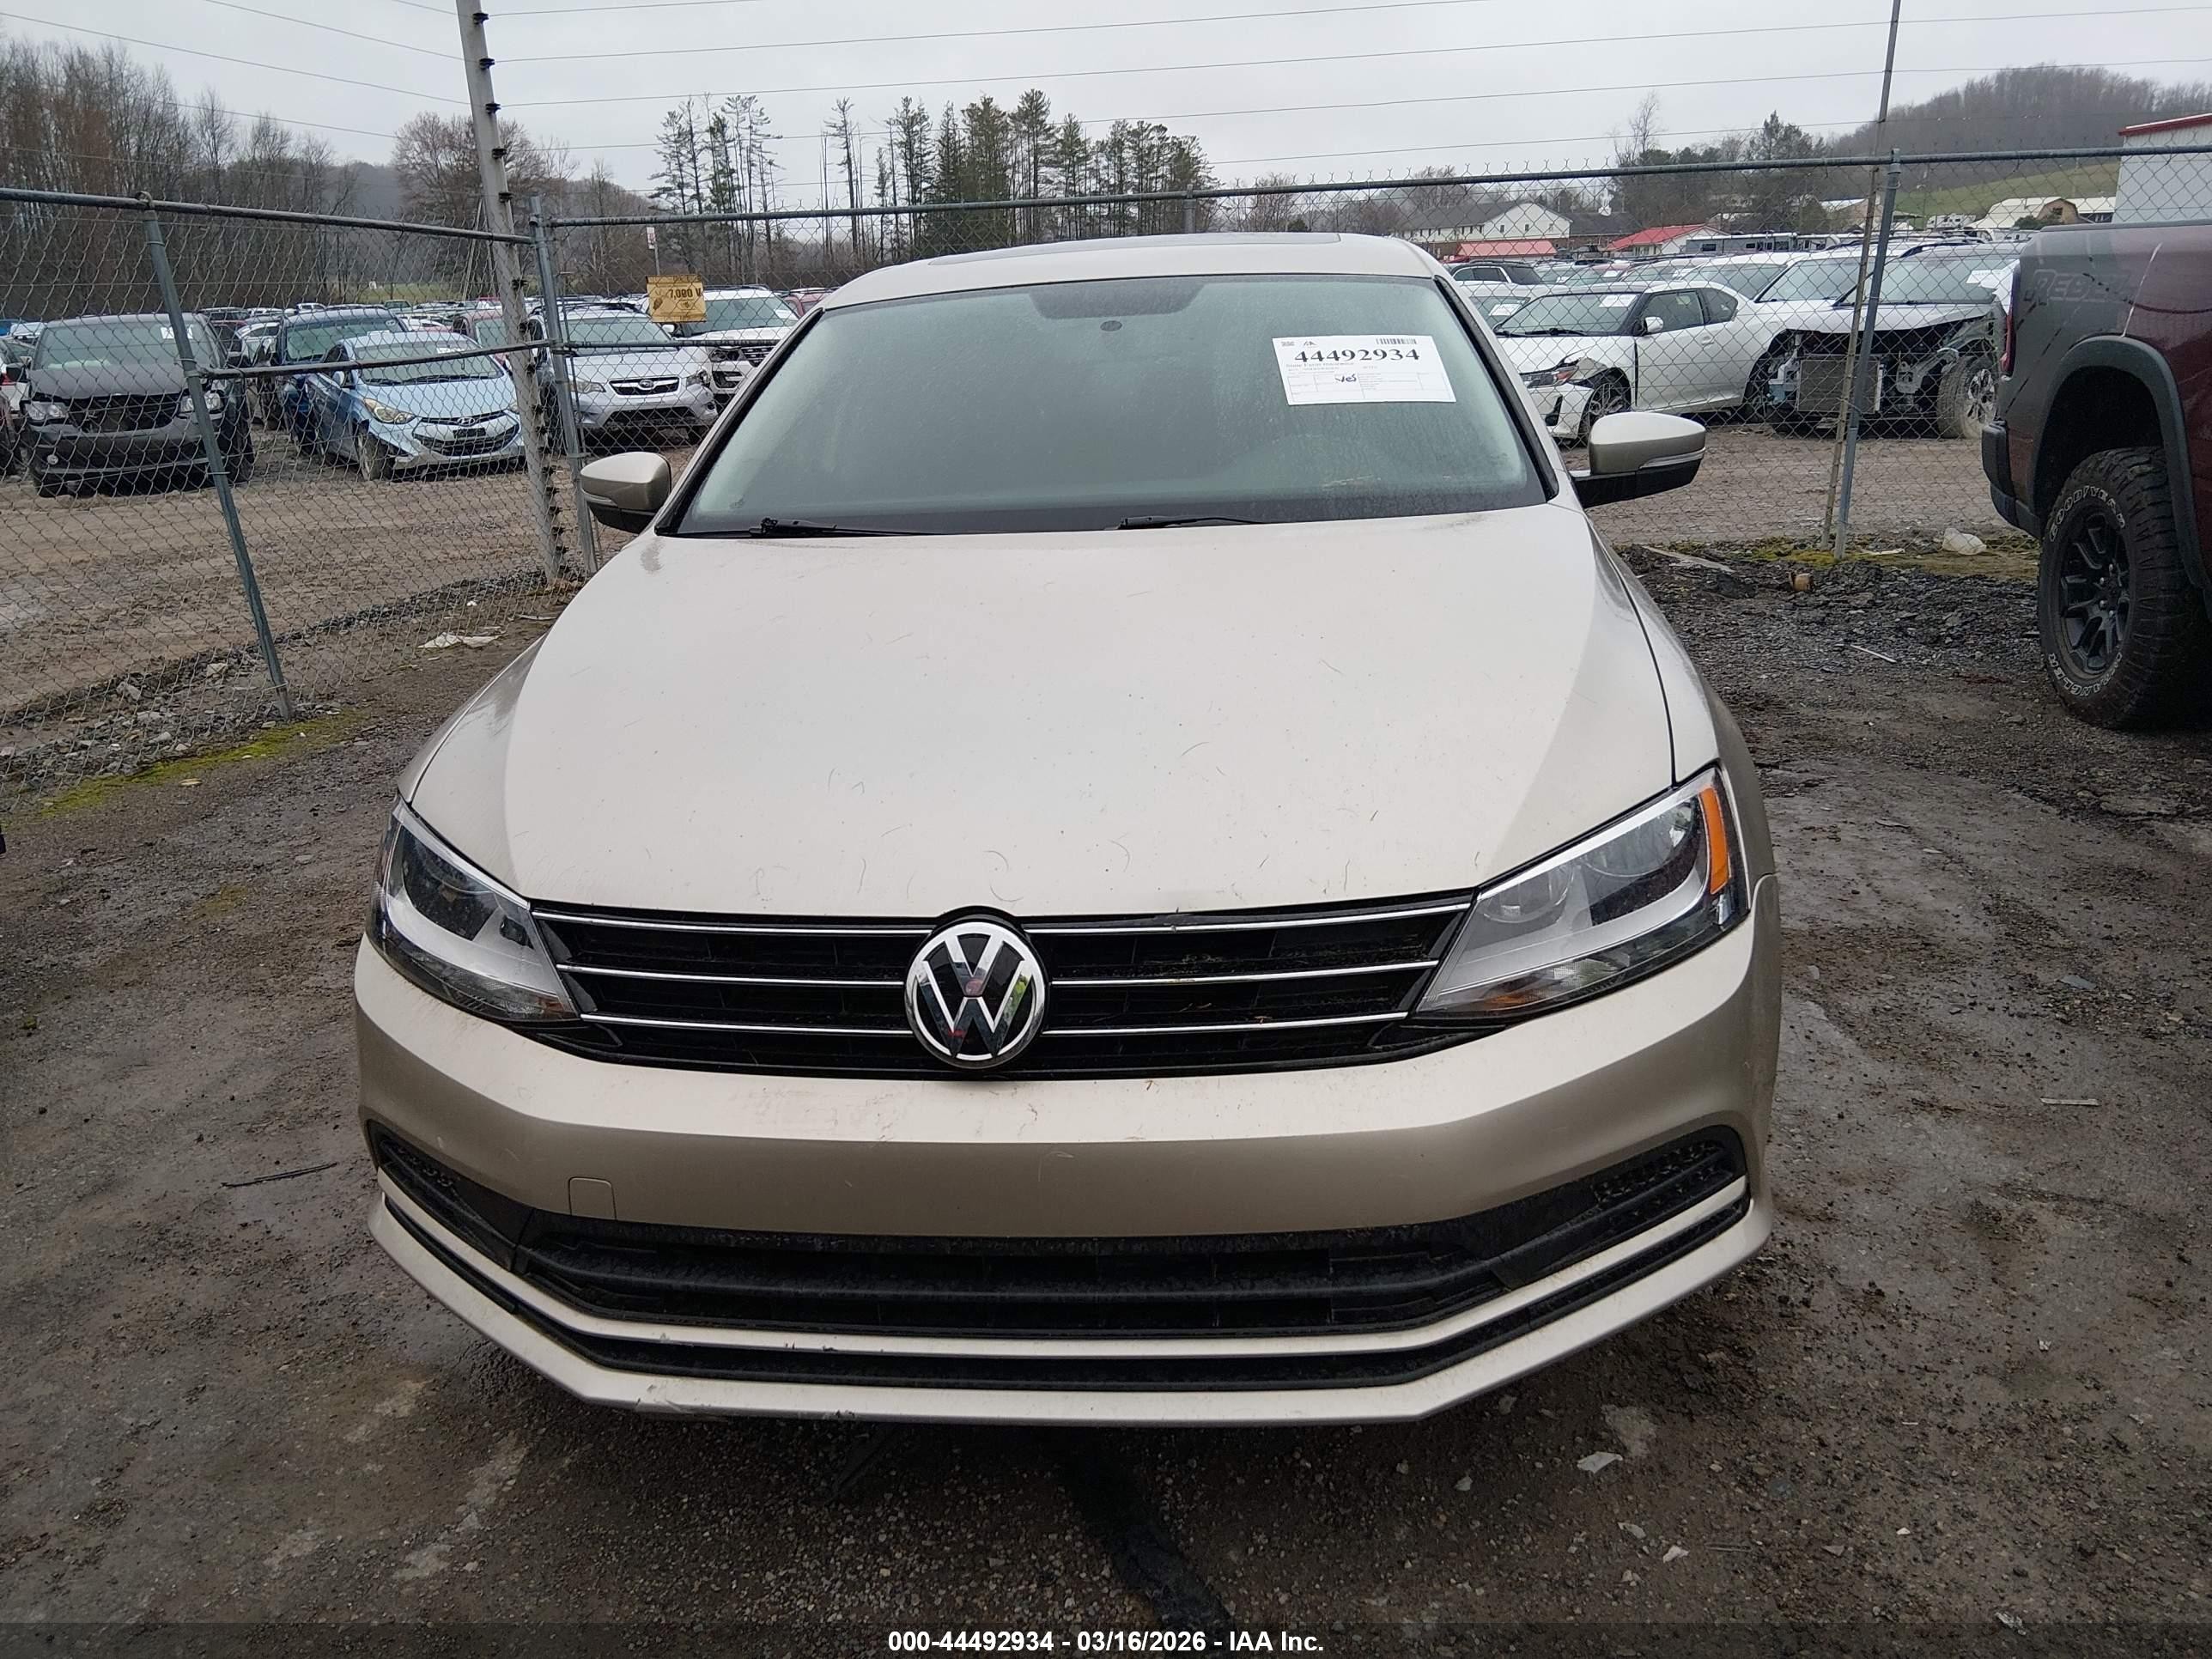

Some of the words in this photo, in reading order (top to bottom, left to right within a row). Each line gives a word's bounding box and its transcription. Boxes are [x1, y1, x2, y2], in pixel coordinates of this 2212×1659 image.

[669, 288, 693, 300] 7,000
[696, 288, 702, 297] V
[1295, 349, 1419, 362] 44492934
[2049, 485, 2126, 542] GOODYEAR
